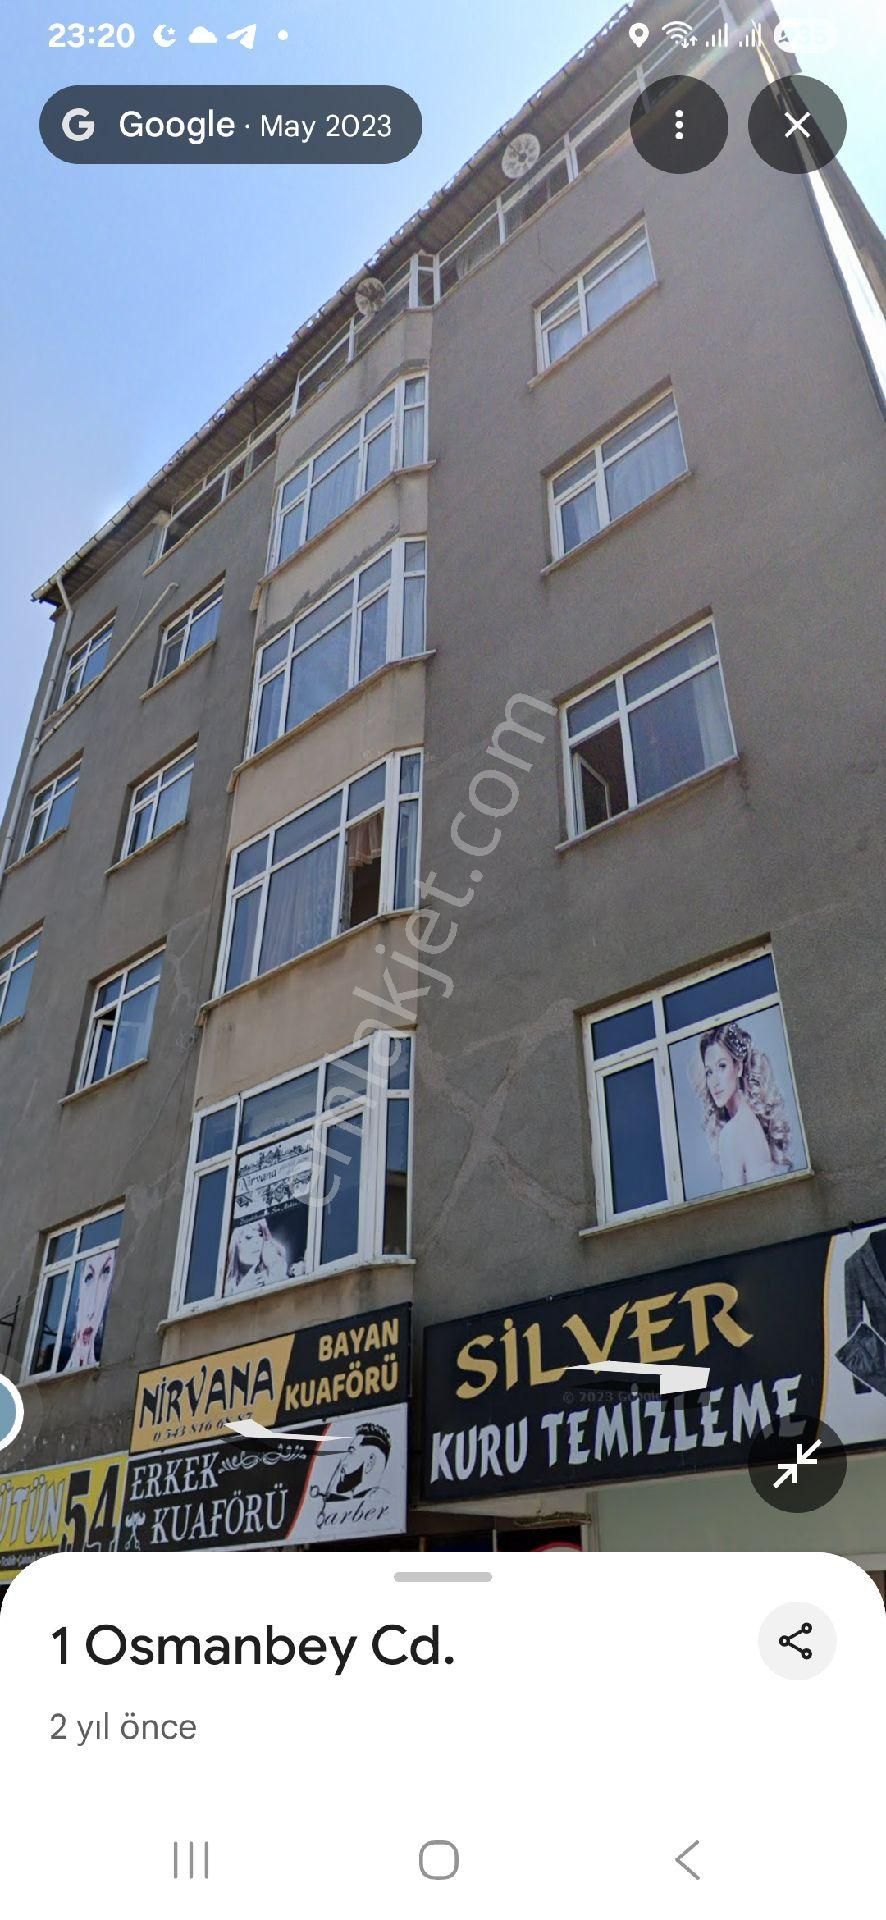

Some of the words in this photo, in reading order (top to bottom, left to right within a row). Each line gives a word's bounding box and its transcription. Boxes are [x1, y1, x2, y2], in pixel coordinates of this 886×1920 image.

[318, 1318, 400, 1362] BAYAN
[455, 1281, 754, 1399] SİLVER
[139, 1357, 275, 1429] NİRVANA
[284, 1358, 399, 1412] KUAFÖRÜ
[430, 1417, 528, 1484] KURU
[540, 1374, 807, 1468] TEMİZLEME
[59, 1464, 121, 1552] 54
[130, 1451, 221, 1502] ERKEK
[150, 1484, 288, 1545] KUAFÖRÜ
